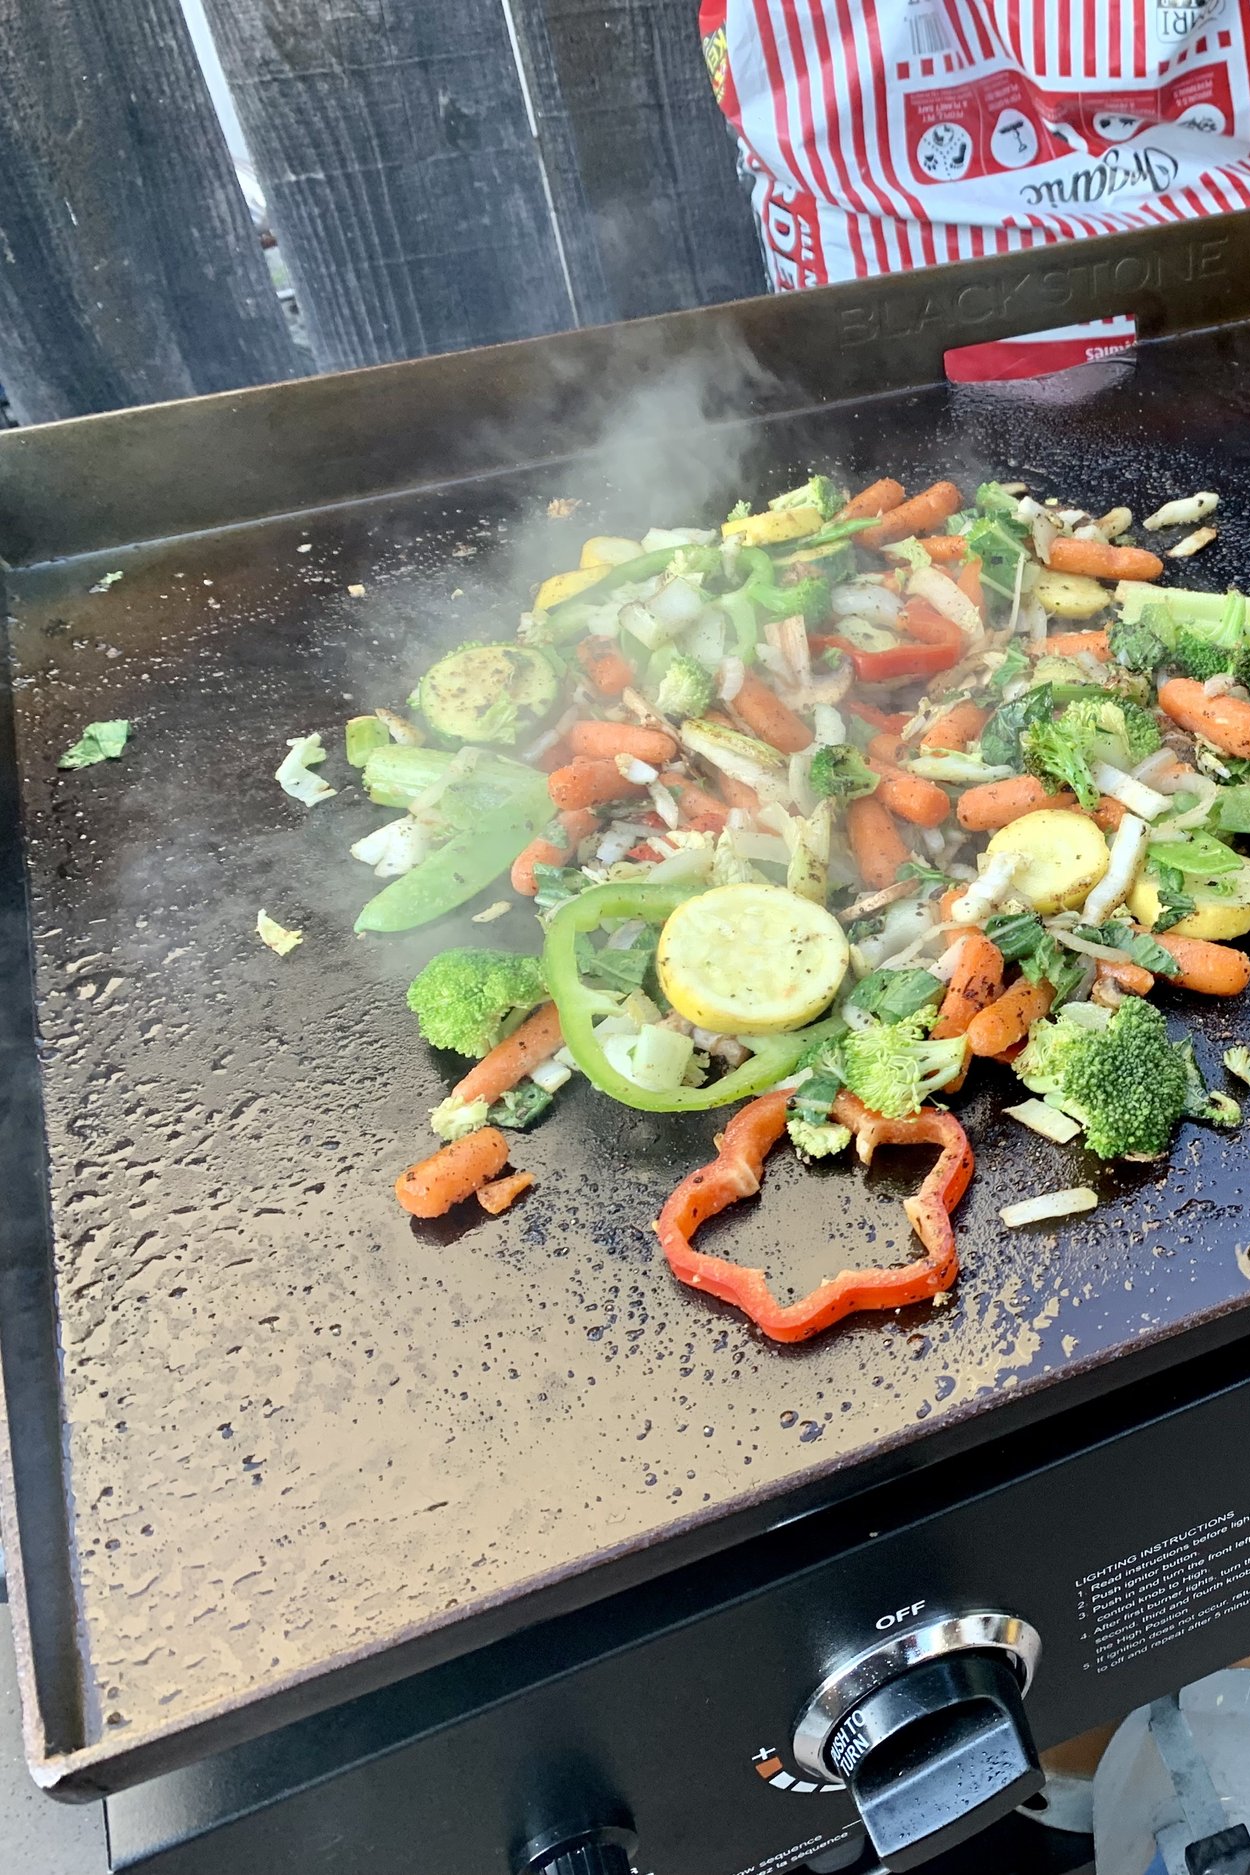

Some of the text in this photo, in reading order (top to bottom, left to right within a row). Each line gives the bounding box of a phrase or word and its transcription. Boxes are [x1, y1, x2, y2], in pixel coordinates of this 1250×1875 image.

[1020, 147, 1178, 208] Organic
[840, 237, 1230, 348] BLACKSTONE
[1076, 1511, 1234, 1587] LIGHTING INSTRUCTIONS
[1091, 1573, 1121, 1591] Read
[1126, 1544, 1189, 1576] instructions
[1193, 1527, 1227, 1546] before
[1092, 1586, 1121, 1602] Push
[1125, 1569, 1159, 1588] ignitor
[1093, 1597, 1121, 1613] Push
[1139, 1579, 1159, 1592] and
[1163, 1569, 1184, 1581] turn
[1188, 1559, 1204, 1570] the
[1208, 1545, 1232, 1561] front
[1236, 1537, 1250, 1548] left
[875, 1599, 926, 1631] OFF
[1094, 1619, 1120, 1634] After
[1124, 1608, 1144, 1620] first
[1147, 1590, 1182, 1610] burner
[1221, 1564, 1240, 1576] turn
[1097, 1600, 1135, 1622] control
[1139, 1588, 1165, 1603] knob
[1143, 1607, 1166, 1622] third
[1169, 1596, 1189, 1610] and
[1193, 1582, 1223, 1599] fourth
[1096, 1643, 1113, 1654] the
[1117, 1630, 1141, 1644] High
[1107, 1638, 1145, 1658] ignition
[1149, 1625, 1174, 1639] does
[1179, 1615, 1194, 1626] not
[1111, 1656, 1124, 1667] off
[1128, 1646, 1147, 1659] and
[1151, 1629, 1184, 1648] repeat
[1188, 1617, 1211, 1631] after
[830, 1709, 865, 1764] PUSH TO
[840, 1734, 870, 1777] TURN
[759, 1834, 823, 1867] sequence
[777, 1831, 848, 1869] la séquence
